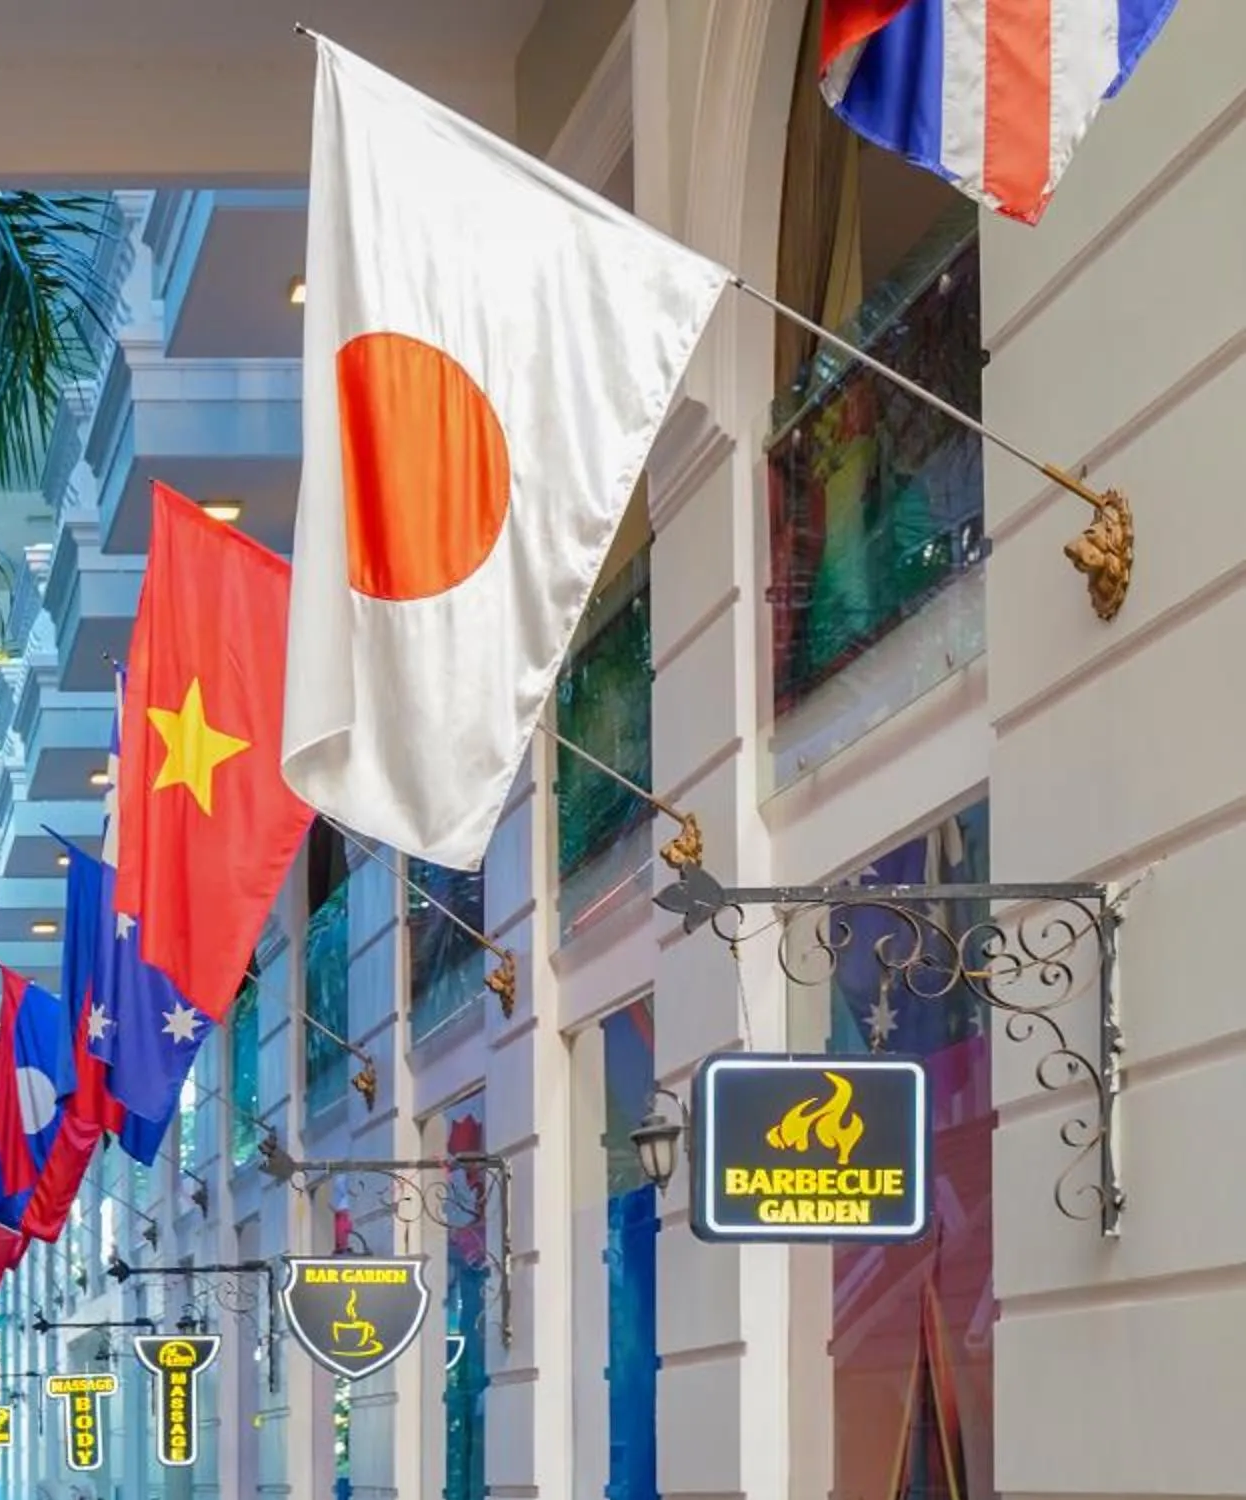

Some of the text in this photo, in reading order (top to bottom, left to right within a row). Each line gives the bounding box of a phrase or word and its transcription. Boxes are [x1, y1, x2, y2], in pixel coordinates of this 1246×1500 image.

[724, 1168, 904, 1196] BARBECUE
[758, 1199, 870, 1224] GARDEN
[305, 1268, 407, 1284] BAR GARDEN
[50, 1377, 114, 1394] MASSAGE
[169, 1371, 187, 1462] MASSAGE
[74, 1396, 95, 1465] BODY
